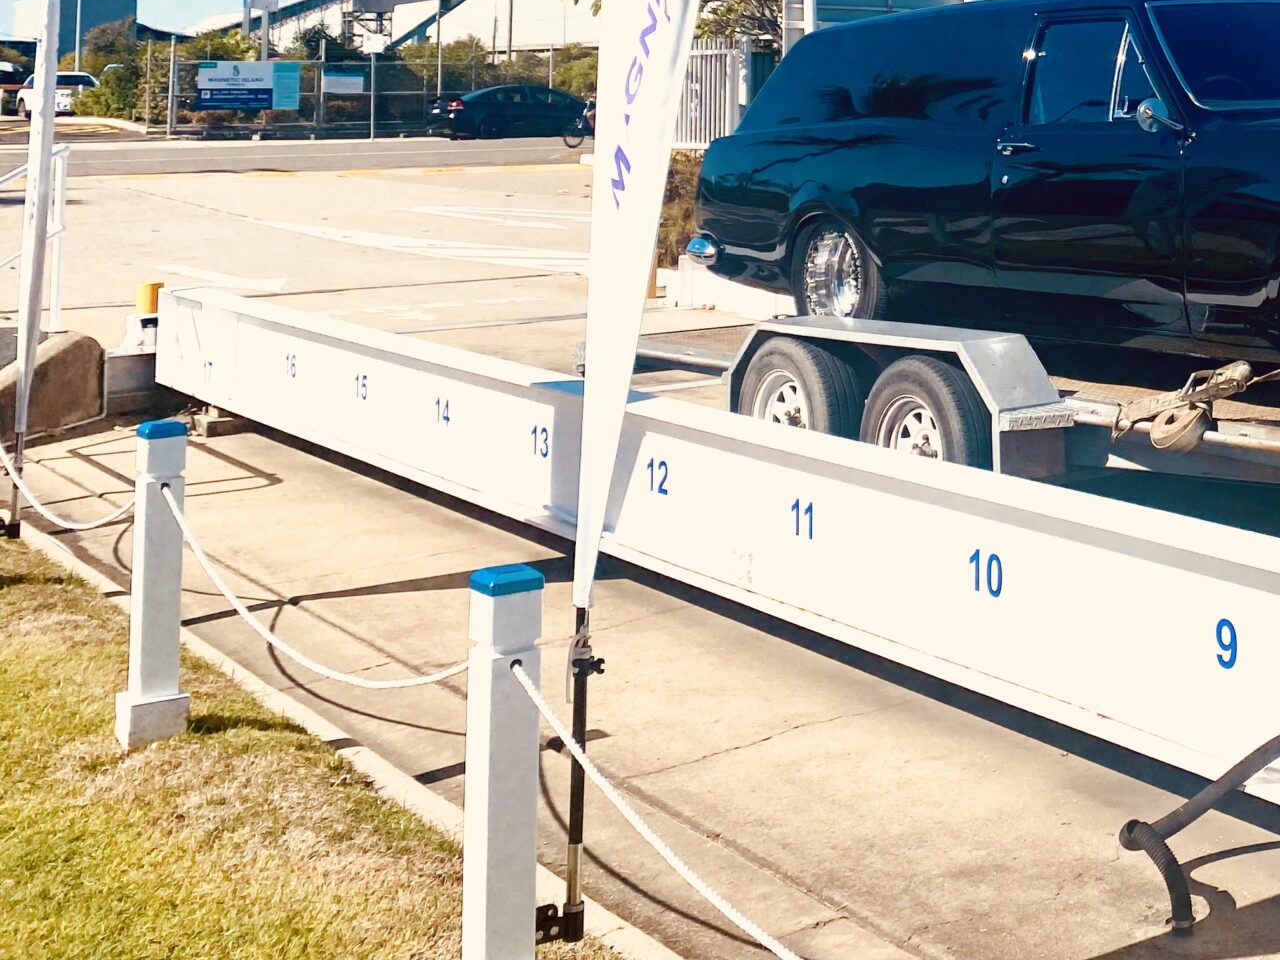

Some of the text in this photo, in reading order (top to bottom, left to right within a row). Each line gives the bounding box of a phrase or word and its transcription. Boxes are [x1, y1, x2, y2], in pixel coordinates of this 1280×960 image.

[286, 353, 296, 378] 16
[354, 373, 368, 401] 15
[434, 397, 450, 426] 14
[530, 425, 549, 459] 13
[647, 457, 669, 496] 12
[791, 498, 814, 540] 11
[968, 548, 1003, 598] 10
[1215, 617, 1238, 670] 9
